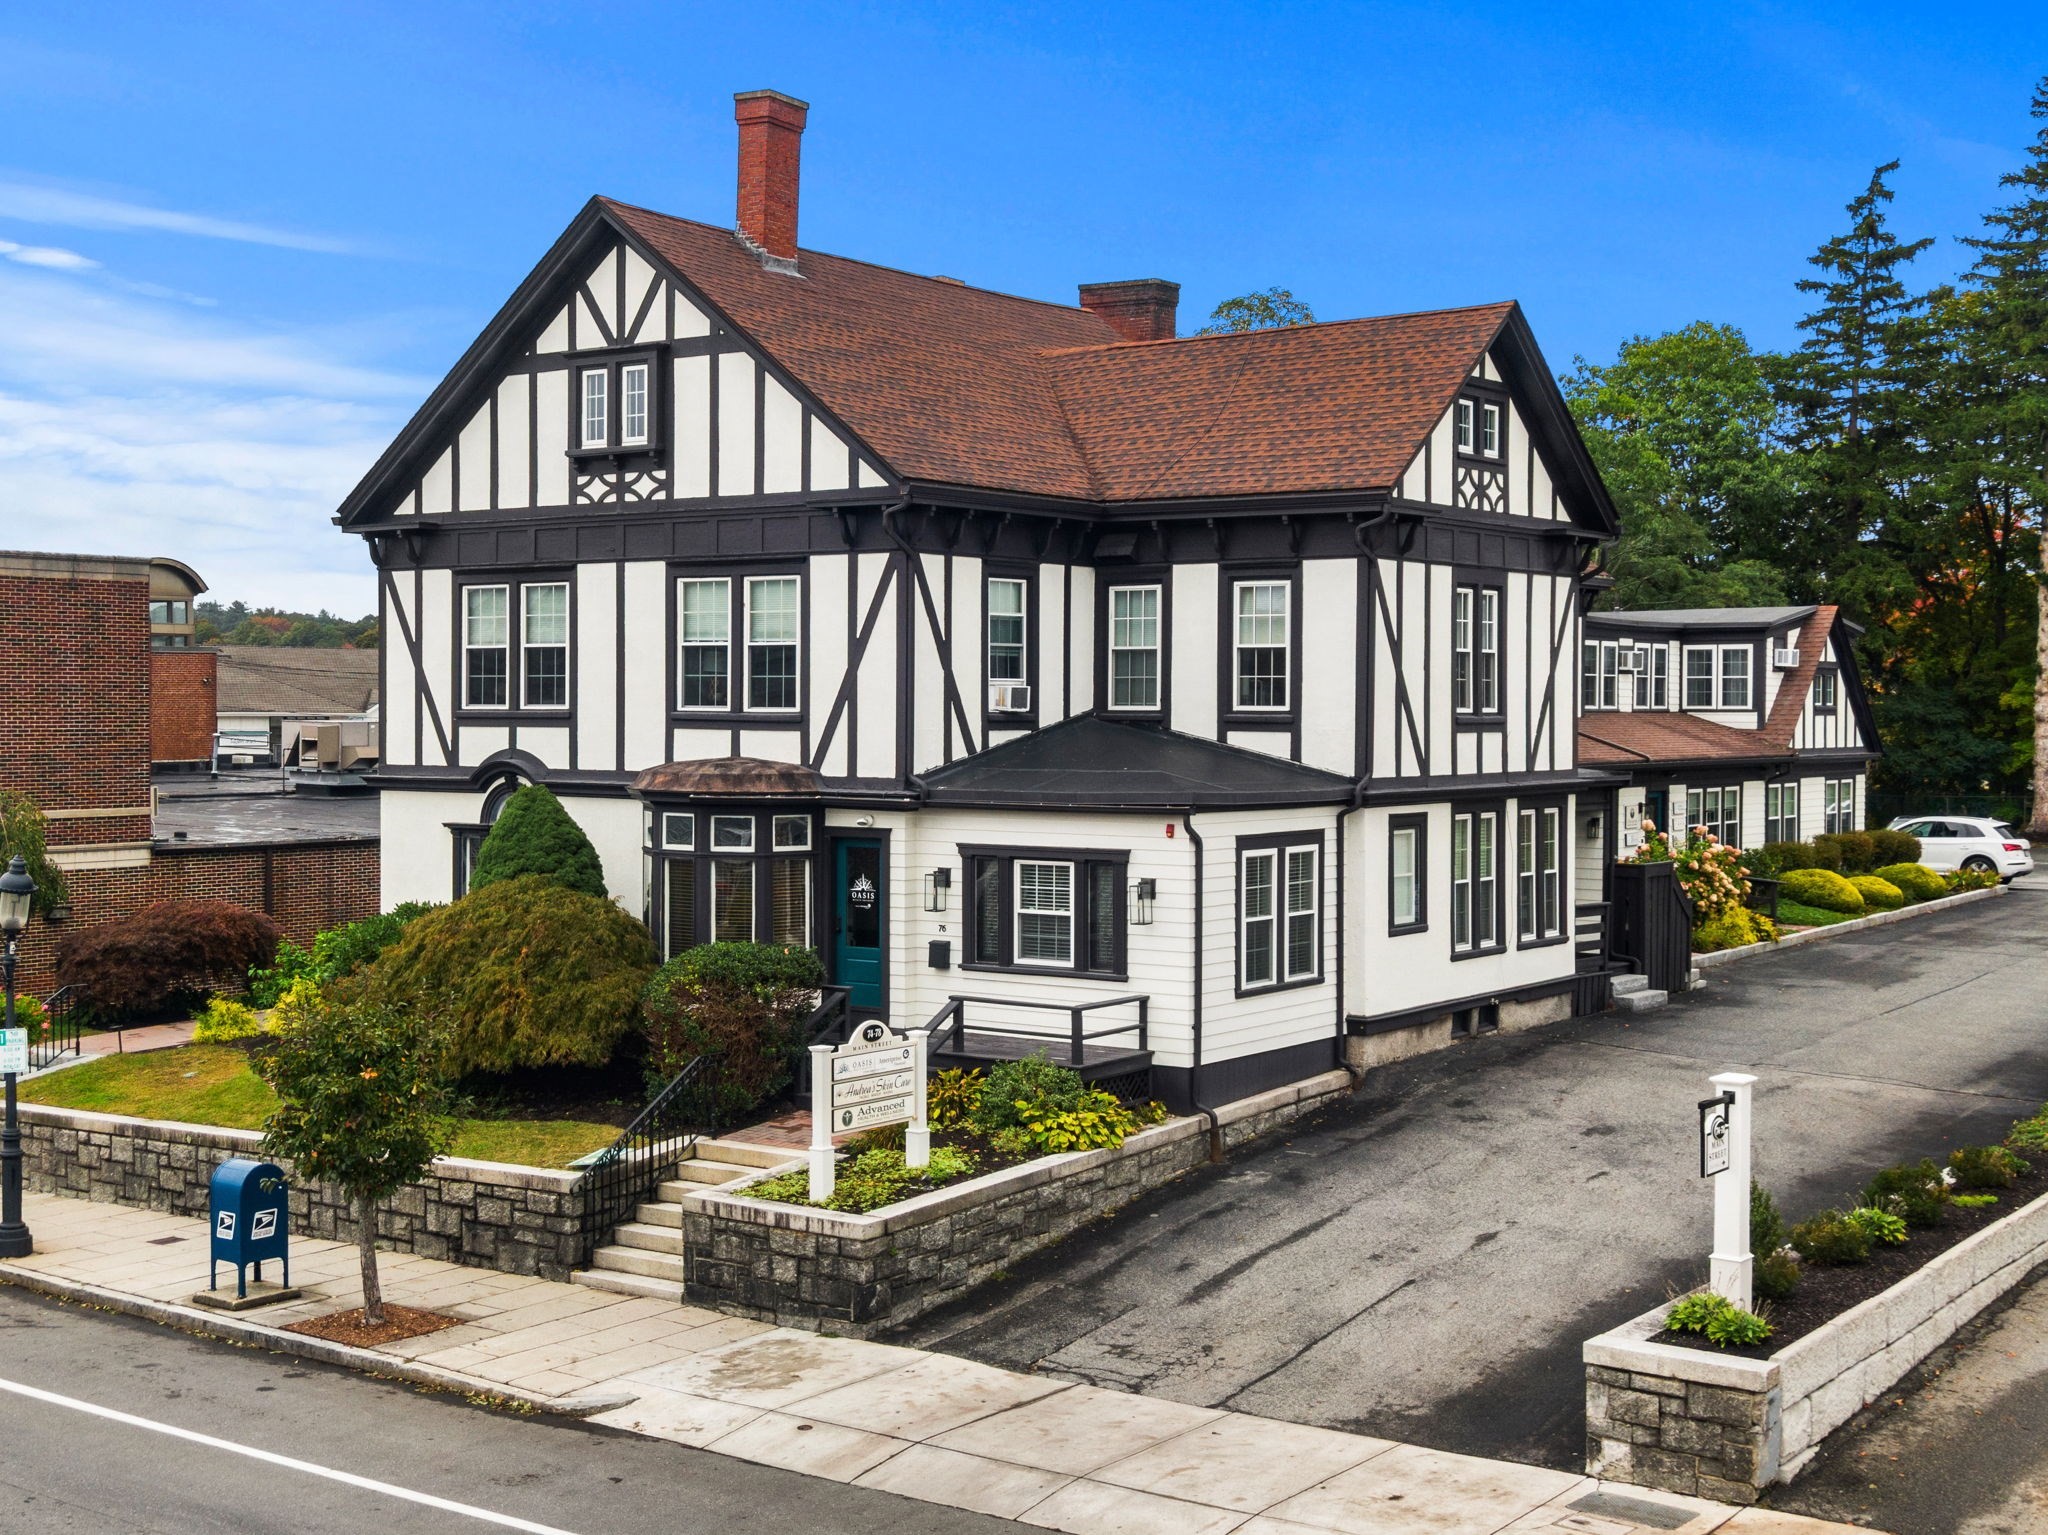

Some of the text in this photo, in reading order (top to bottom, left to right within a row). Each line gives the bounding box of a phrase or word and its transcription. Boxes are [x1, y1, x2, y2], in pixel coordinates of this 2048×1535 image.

[851, 891, 875, 900] OASIS
[938, 924, 947, 932] 76
[866, 1028, 882, 1039] 74-78
[853, 1041, 892, 1051] MAIN STREET
[852, 1059, 873, 1068] OASIS
[846, 1081, 875, 1097] Andrea's
[876, 1078, 893, 1092] Skin
[894, 1075, 911, 1088] Care
[857, 1099, 905, 1117] Advanced
[857, 1112, 875, 1120] HEALTH
[880, 1108, 905, 1117] WELLNESS
[1711, 1139, 1725, 1149] MAIN
[1709, 1148, 1727, 1161] STREET
